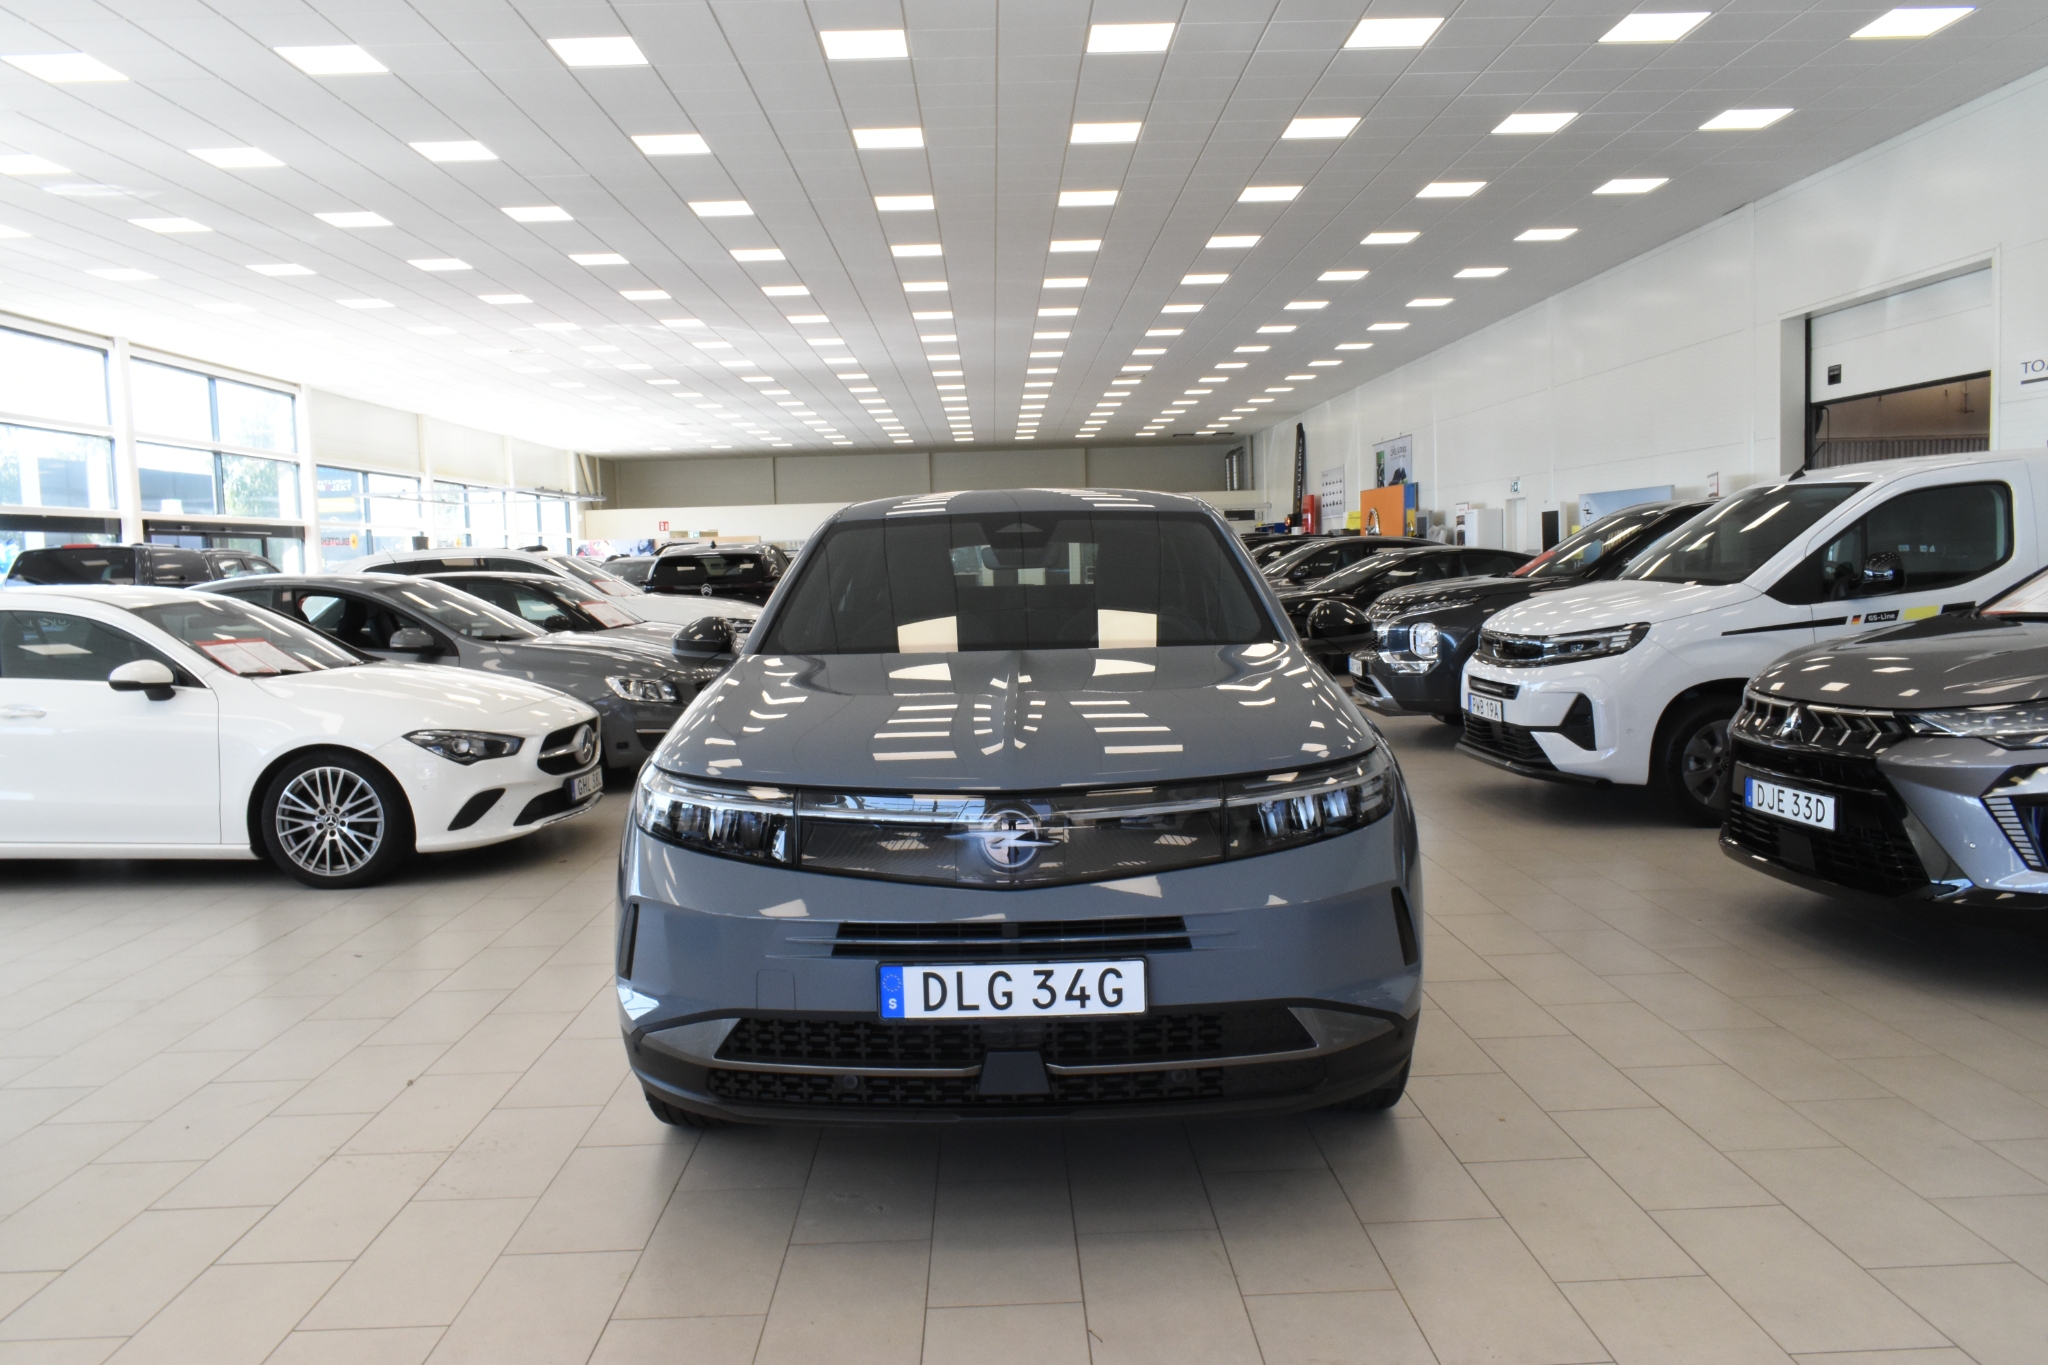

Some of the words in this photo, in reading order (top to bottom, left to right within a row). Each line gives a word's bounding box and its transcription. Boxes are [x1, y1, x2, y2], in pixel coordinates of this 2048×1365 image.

[2020, 359, 2048, 374] TO
[1867, 612, 1896, 621] GS-Line
[1486, 701, 1499, 719] 19A
[1757, 783, 1785, 814] DJE
[1791, 793, 1826, 823] 33D
[922, 970, 1014, 1012] DLG
[1031, 967, 1124, 1010] 34G
[888, 998, 898, 1010] S
